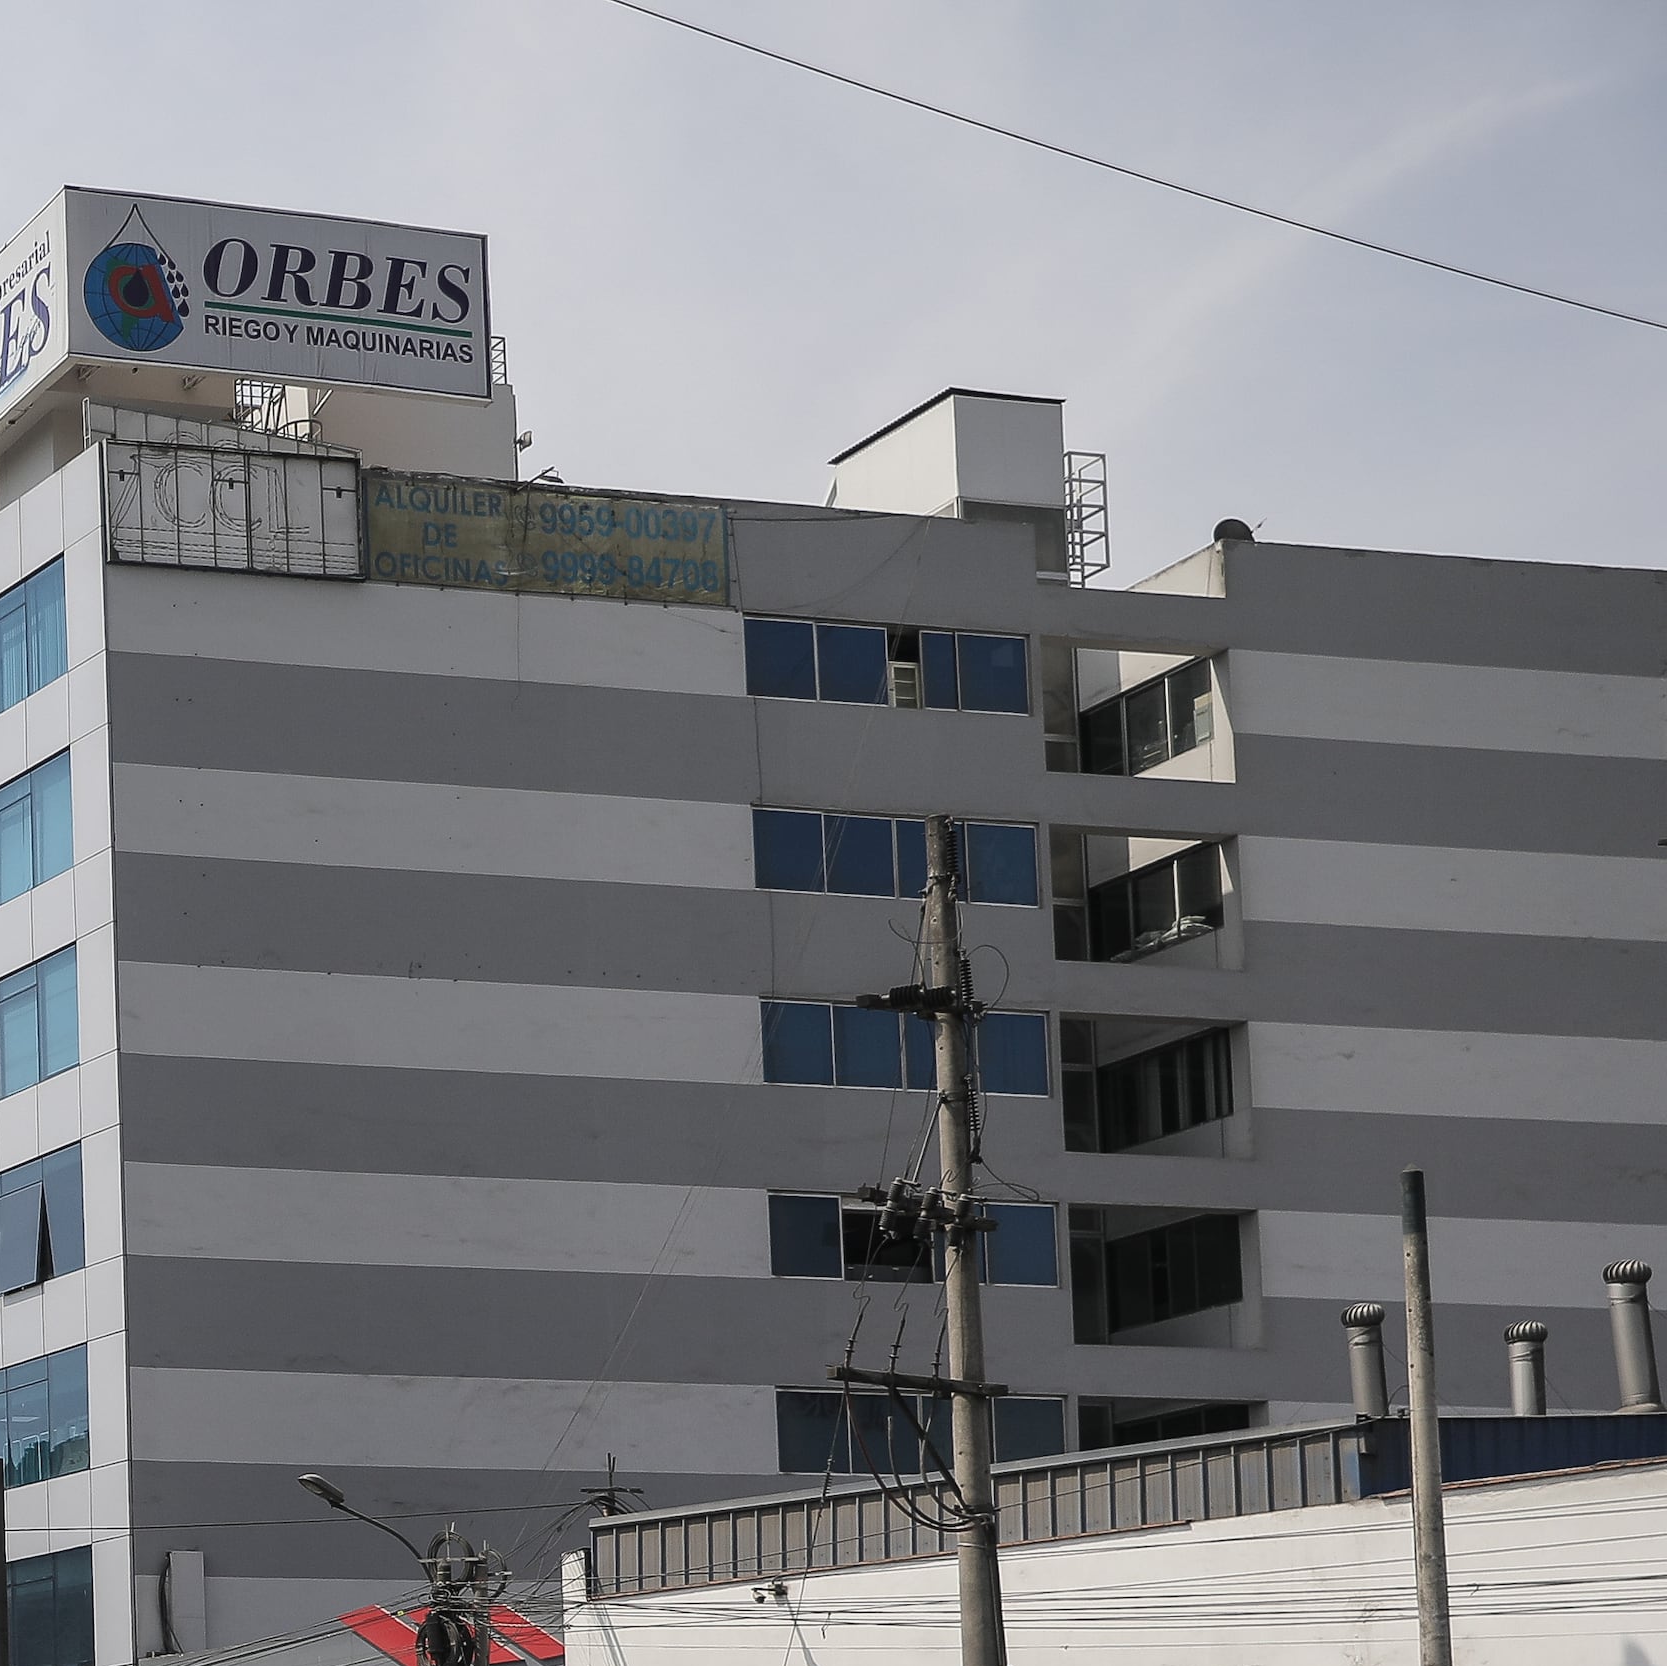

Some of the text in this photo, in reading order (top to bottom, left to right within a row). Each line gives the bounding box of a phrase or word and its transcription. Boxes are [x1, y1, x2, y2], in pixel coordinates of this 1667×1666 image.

[202, 237, 471, 325] ORBES
[203, 313, 474, 364] RIEGO Y MAQUINARIAS
[373, 483, 503, 518] ALQUILER
[422, 521, 459, 548] DE
[373, 551, 510, 587] OFICINAS
